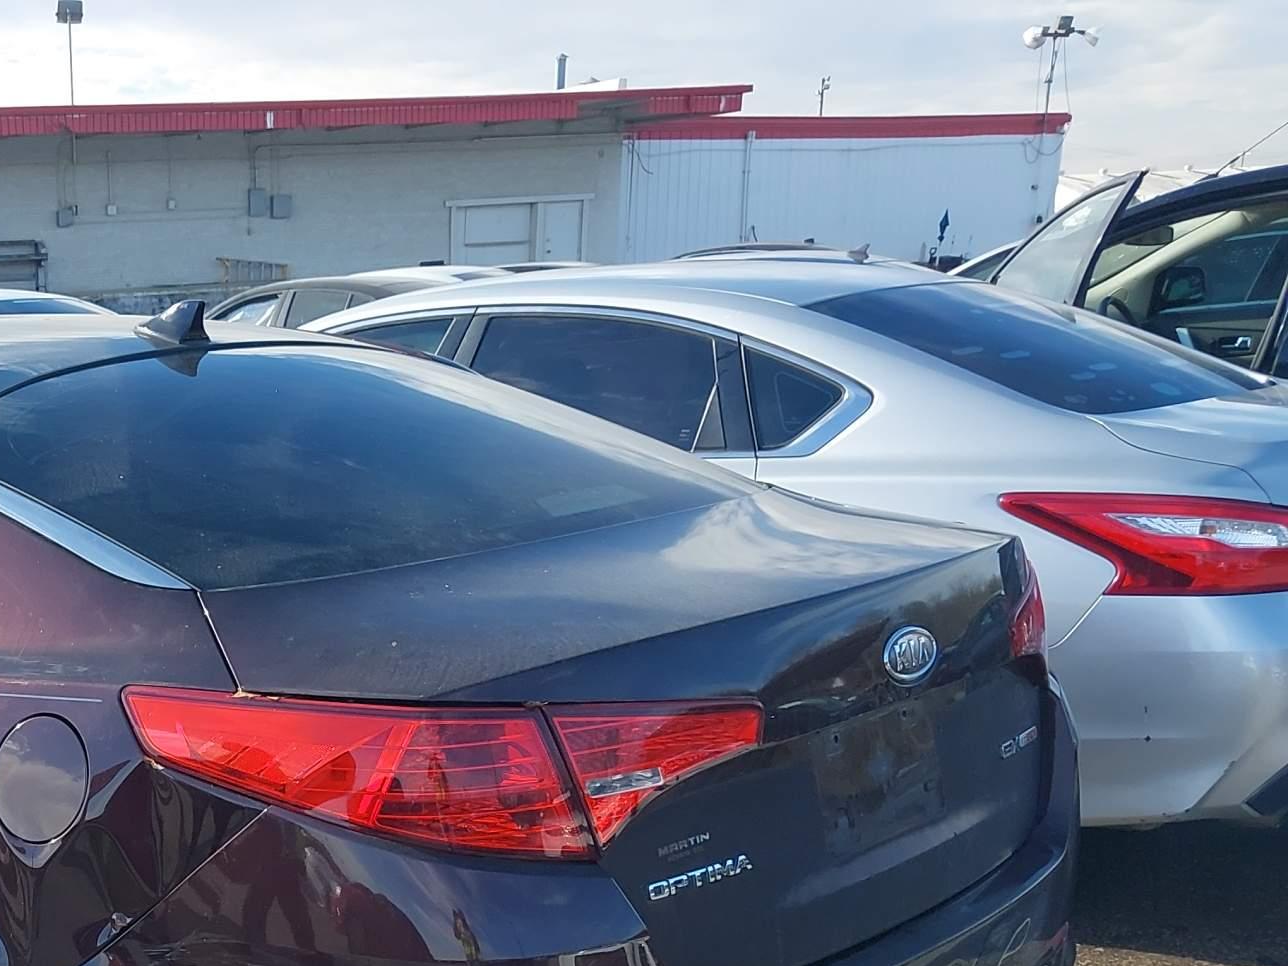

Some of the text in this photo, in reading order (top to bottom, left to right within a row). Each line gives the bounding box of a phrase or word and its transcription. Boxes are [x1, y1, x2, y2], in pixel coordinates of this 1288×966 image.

[894, 635, 930, 672] KIA
[657, 832, 710, 857] MARTIN
[648, 854, 753, 901] OPTIMA
